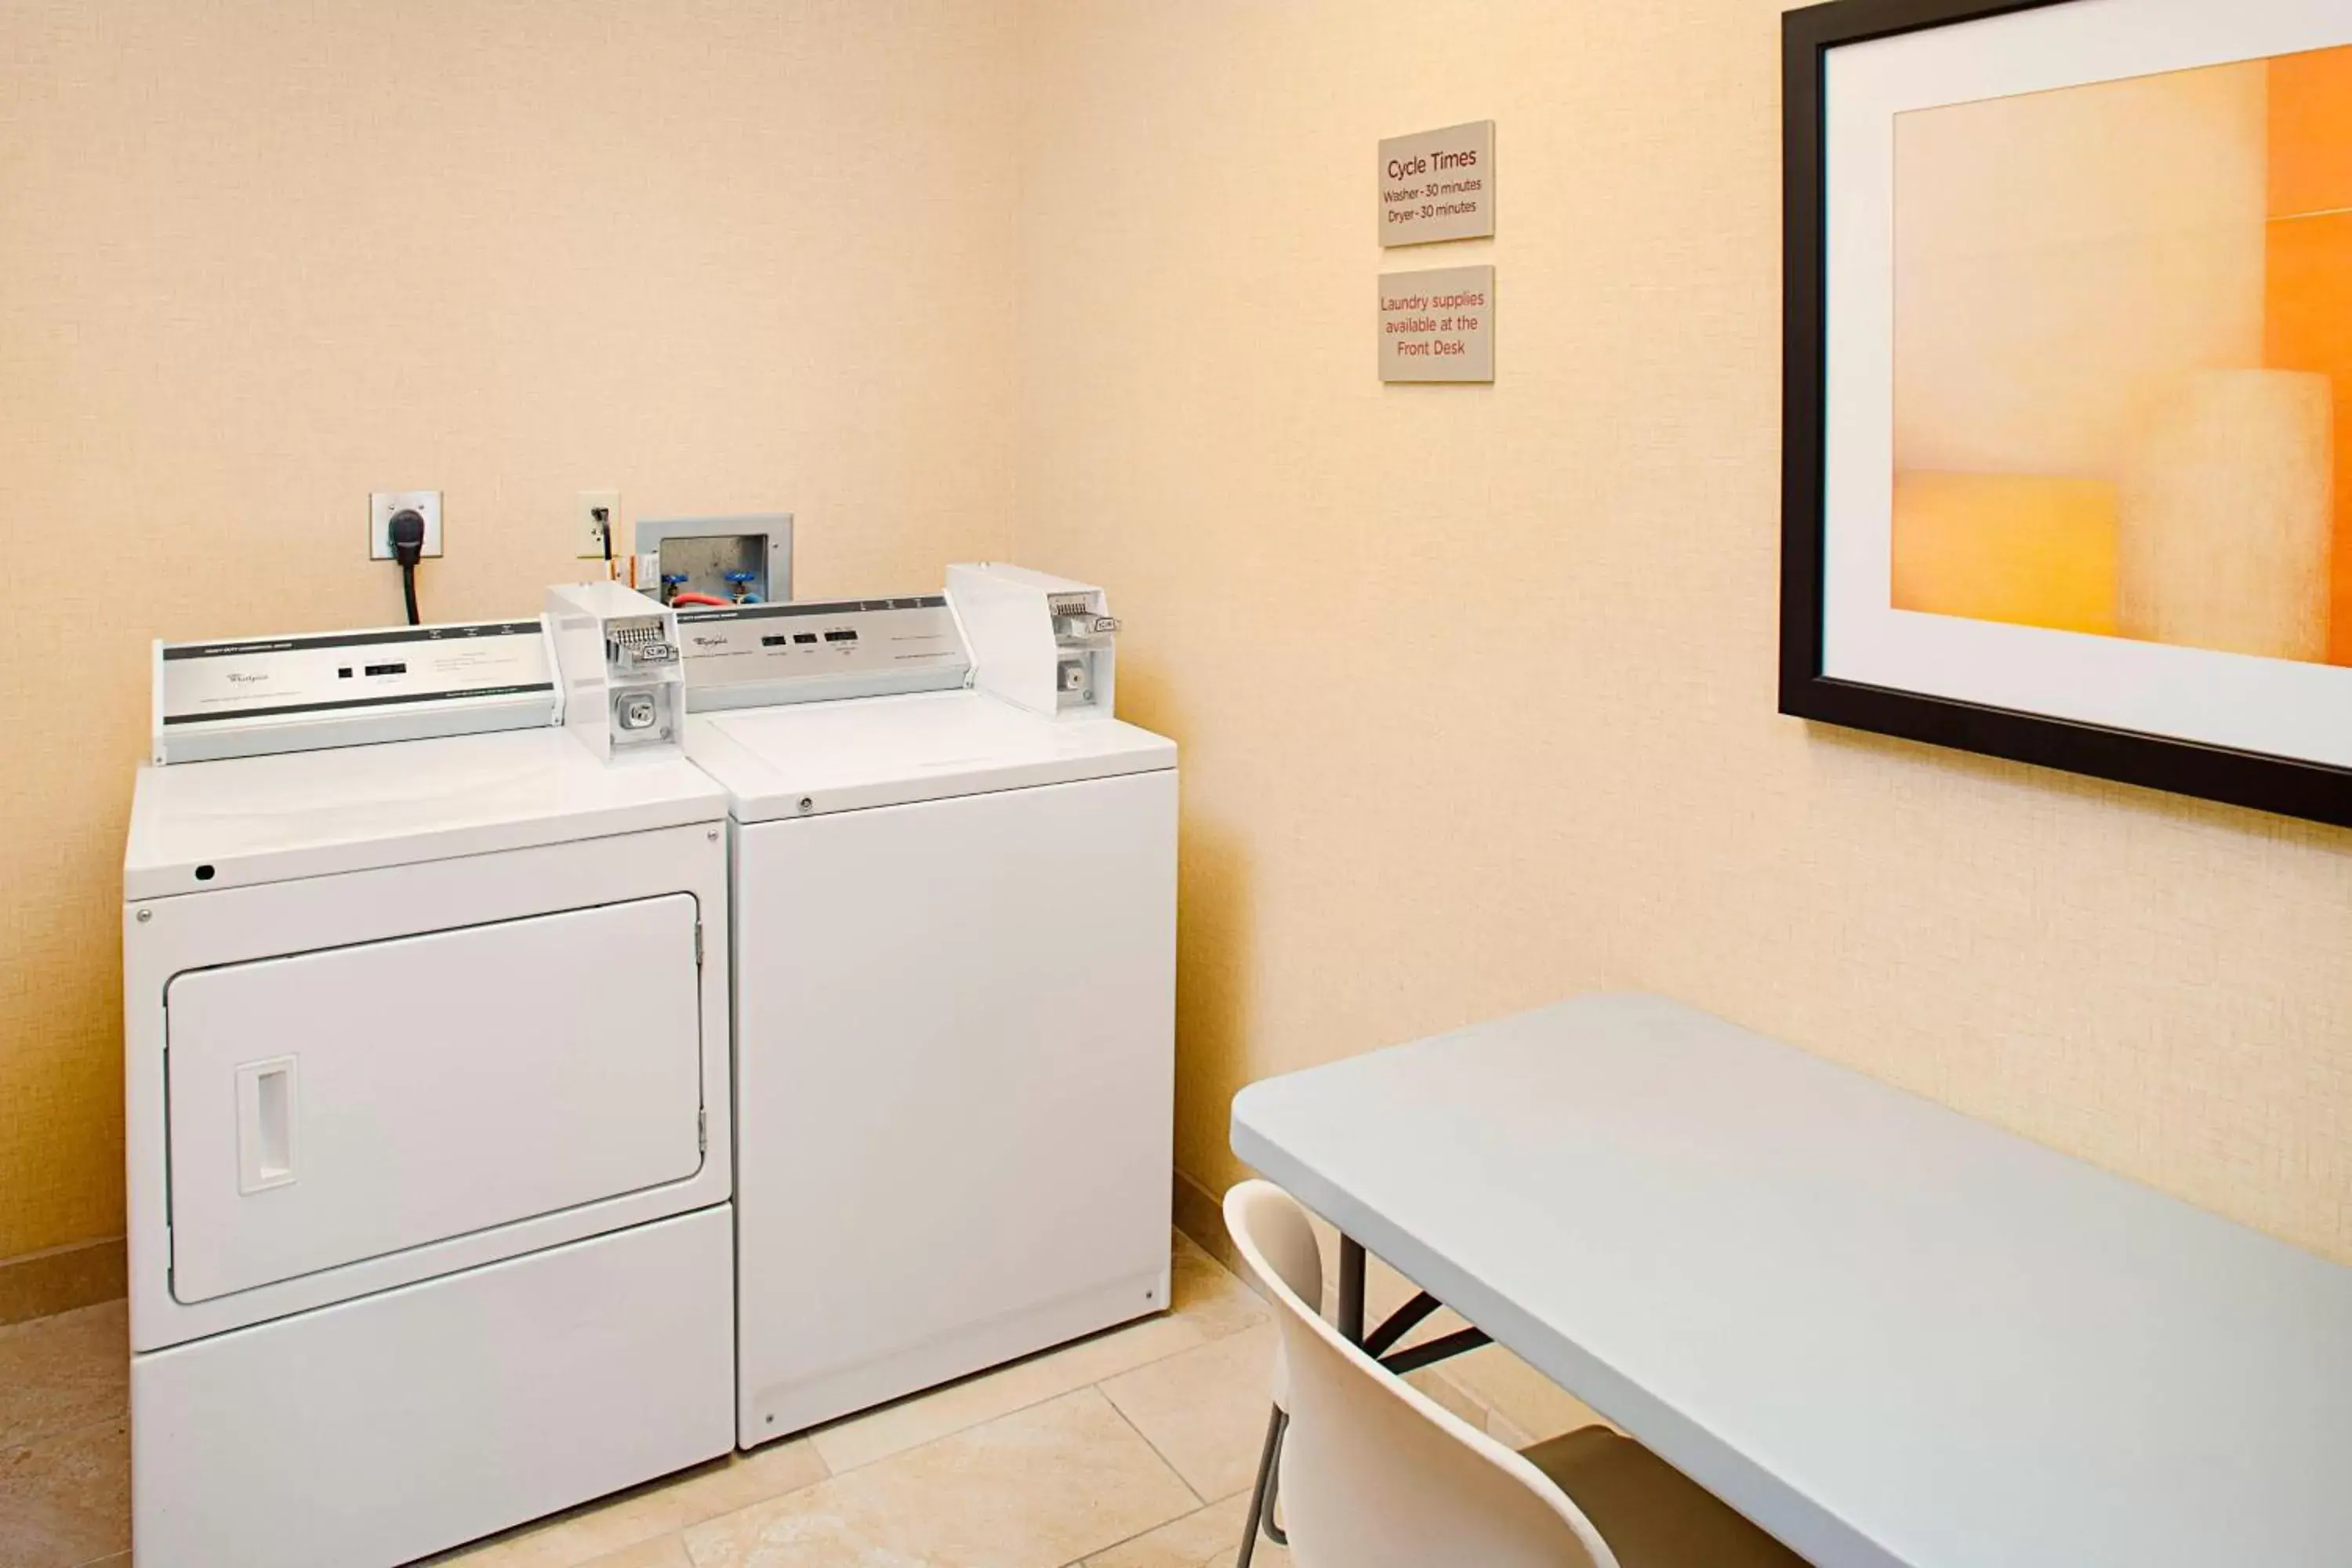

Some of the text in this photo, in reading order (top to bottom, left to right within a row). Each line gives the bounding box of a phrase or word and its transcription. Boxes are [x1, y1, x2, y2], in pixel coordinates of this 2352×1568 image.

[1388, 150, 1477, 180] Cycle Times
[1440, 179, 1482, 194] minutes
[1436, 201, 1477, 216] minutes
[1381, 291, 1484, 311] Laundry supplies
[1385, 314, 1478, 333] available at the
[1398, 339, 1465, 356] Front Desk
